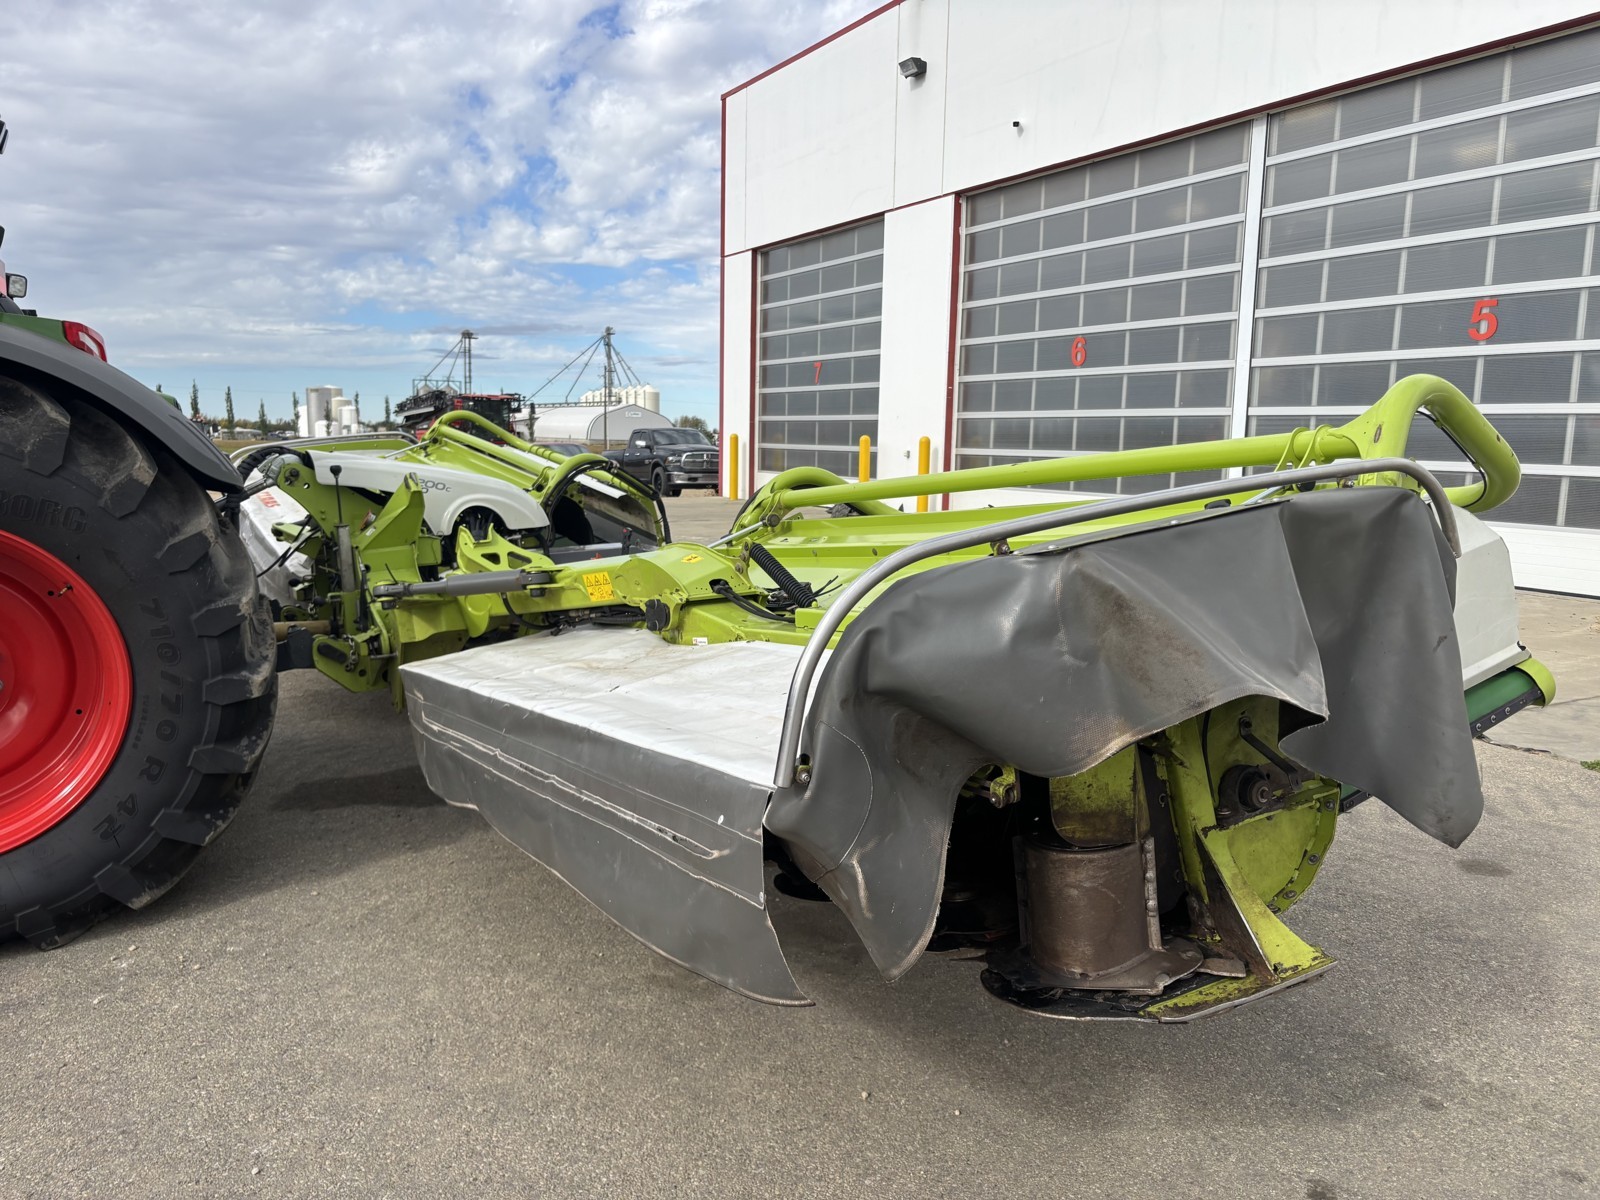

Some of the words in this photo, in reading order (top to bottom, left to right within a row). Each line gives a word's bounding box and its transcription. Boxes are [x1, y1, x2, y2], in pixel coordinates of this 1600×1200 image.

[1467, 299, 1499, 341] 5
[1071, 336, 1087, 367] 6
[813, 362, 823, 384] 7
[139, 597, 184, 743] 710/70
[139, 754, 168, 785] R
[92, 793, 139, 841] 42
